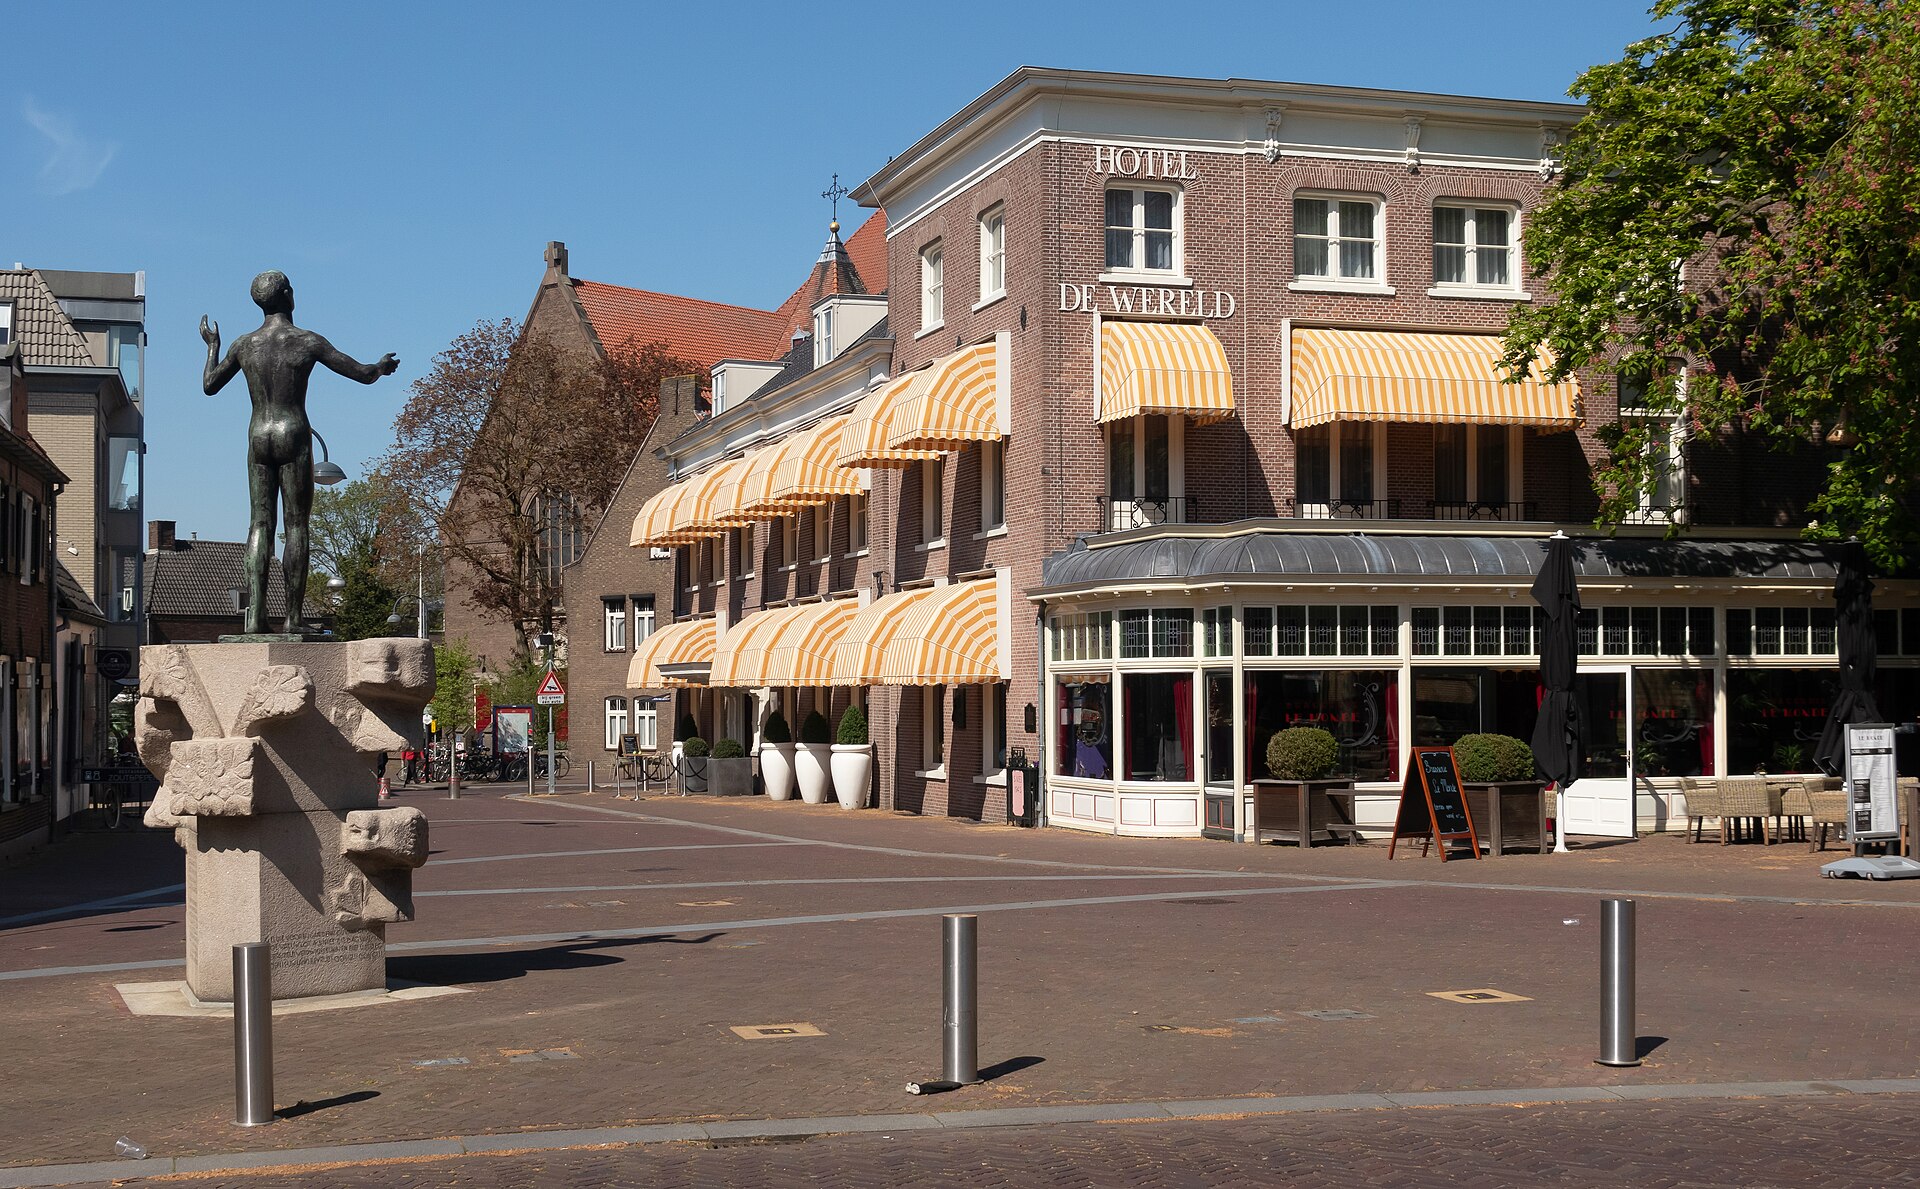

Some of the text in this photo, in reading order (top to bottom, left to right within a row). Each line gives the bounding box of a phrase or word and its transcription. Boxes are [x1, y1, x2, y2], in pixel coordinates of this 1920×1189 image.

[1092, 145, 1197, 179] HOTEL
[1058, 283, 1235, 319] DE WERELD
[1285, 712, 1303, 722] LE
